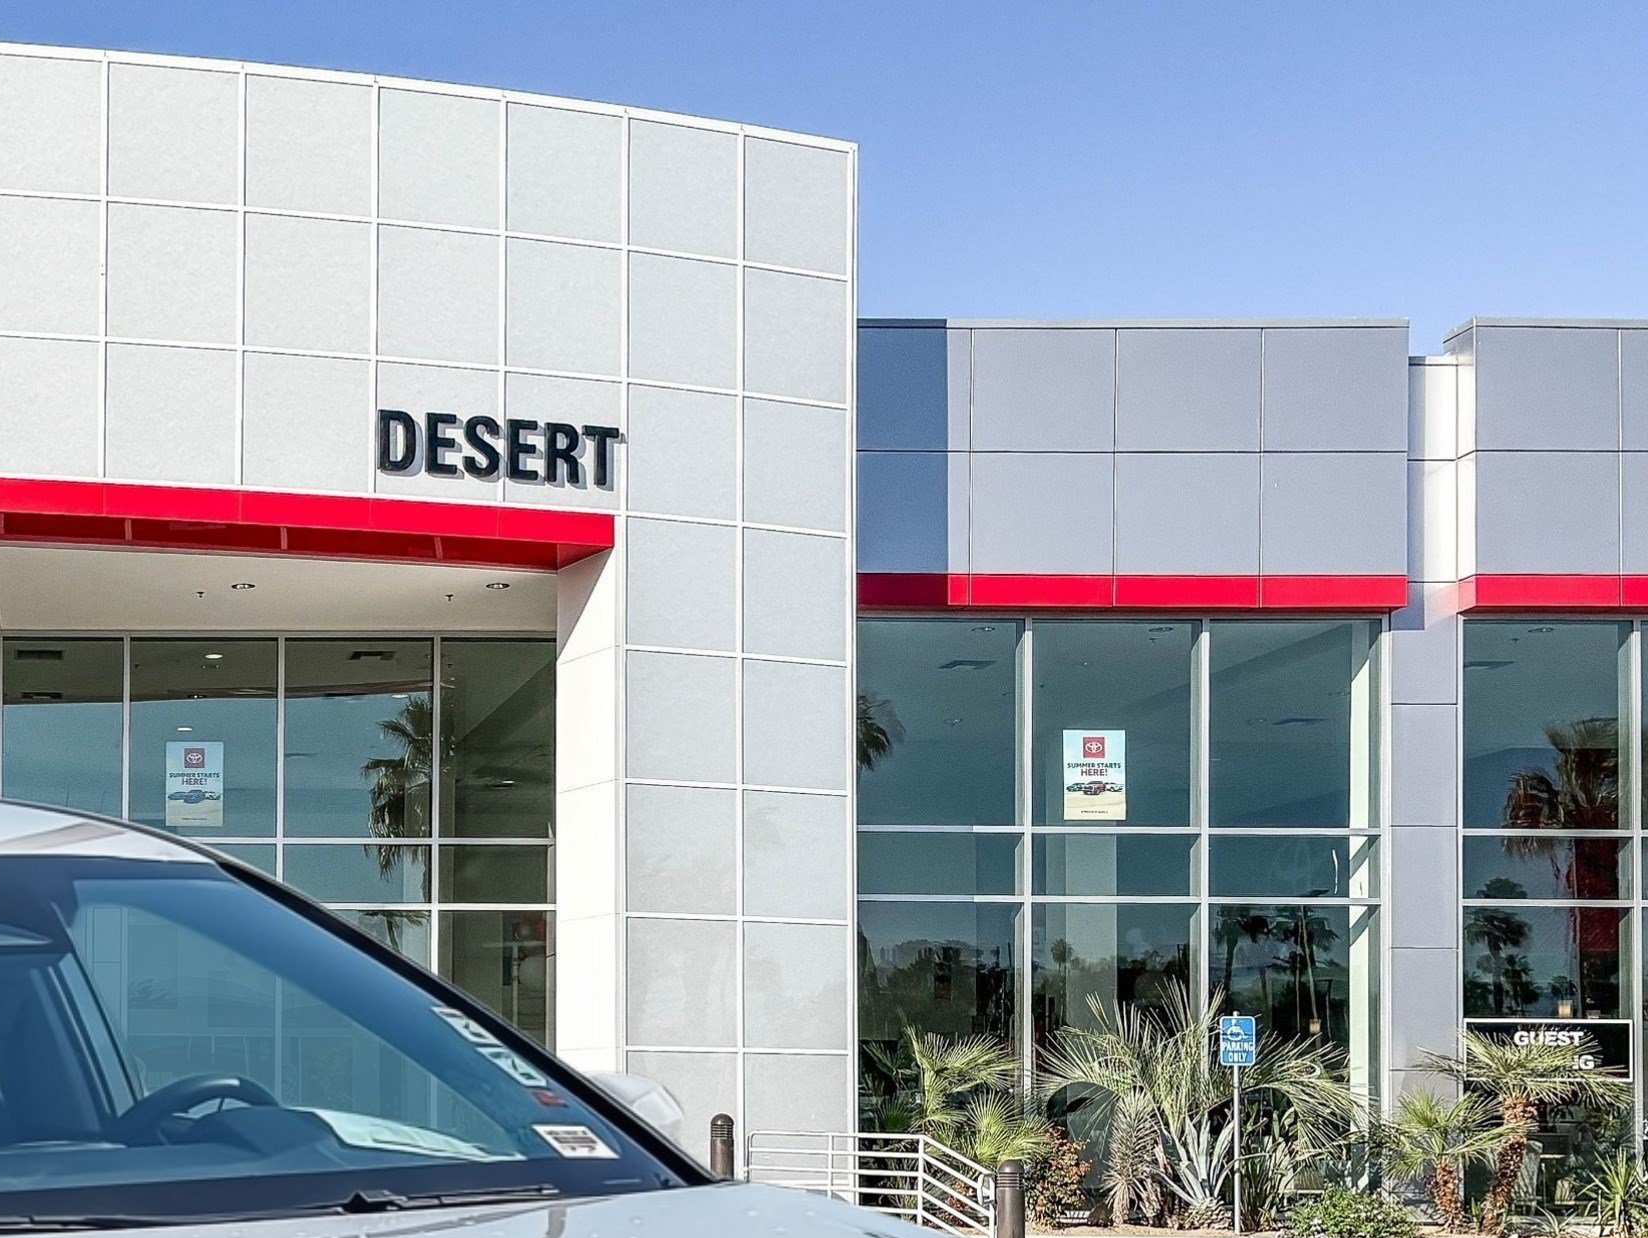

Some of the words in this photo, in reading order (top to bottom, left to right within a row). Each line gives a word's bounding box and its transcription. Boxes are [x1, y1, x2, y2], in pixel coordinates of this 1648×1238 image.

[377, 408, 620, 487] DESERT
[1514, 1031, 1584, 1047] GUEST
[1222, 1041, 1254, 1051] PARKING
[1228, 1052, 1248, 1062] ONLY
